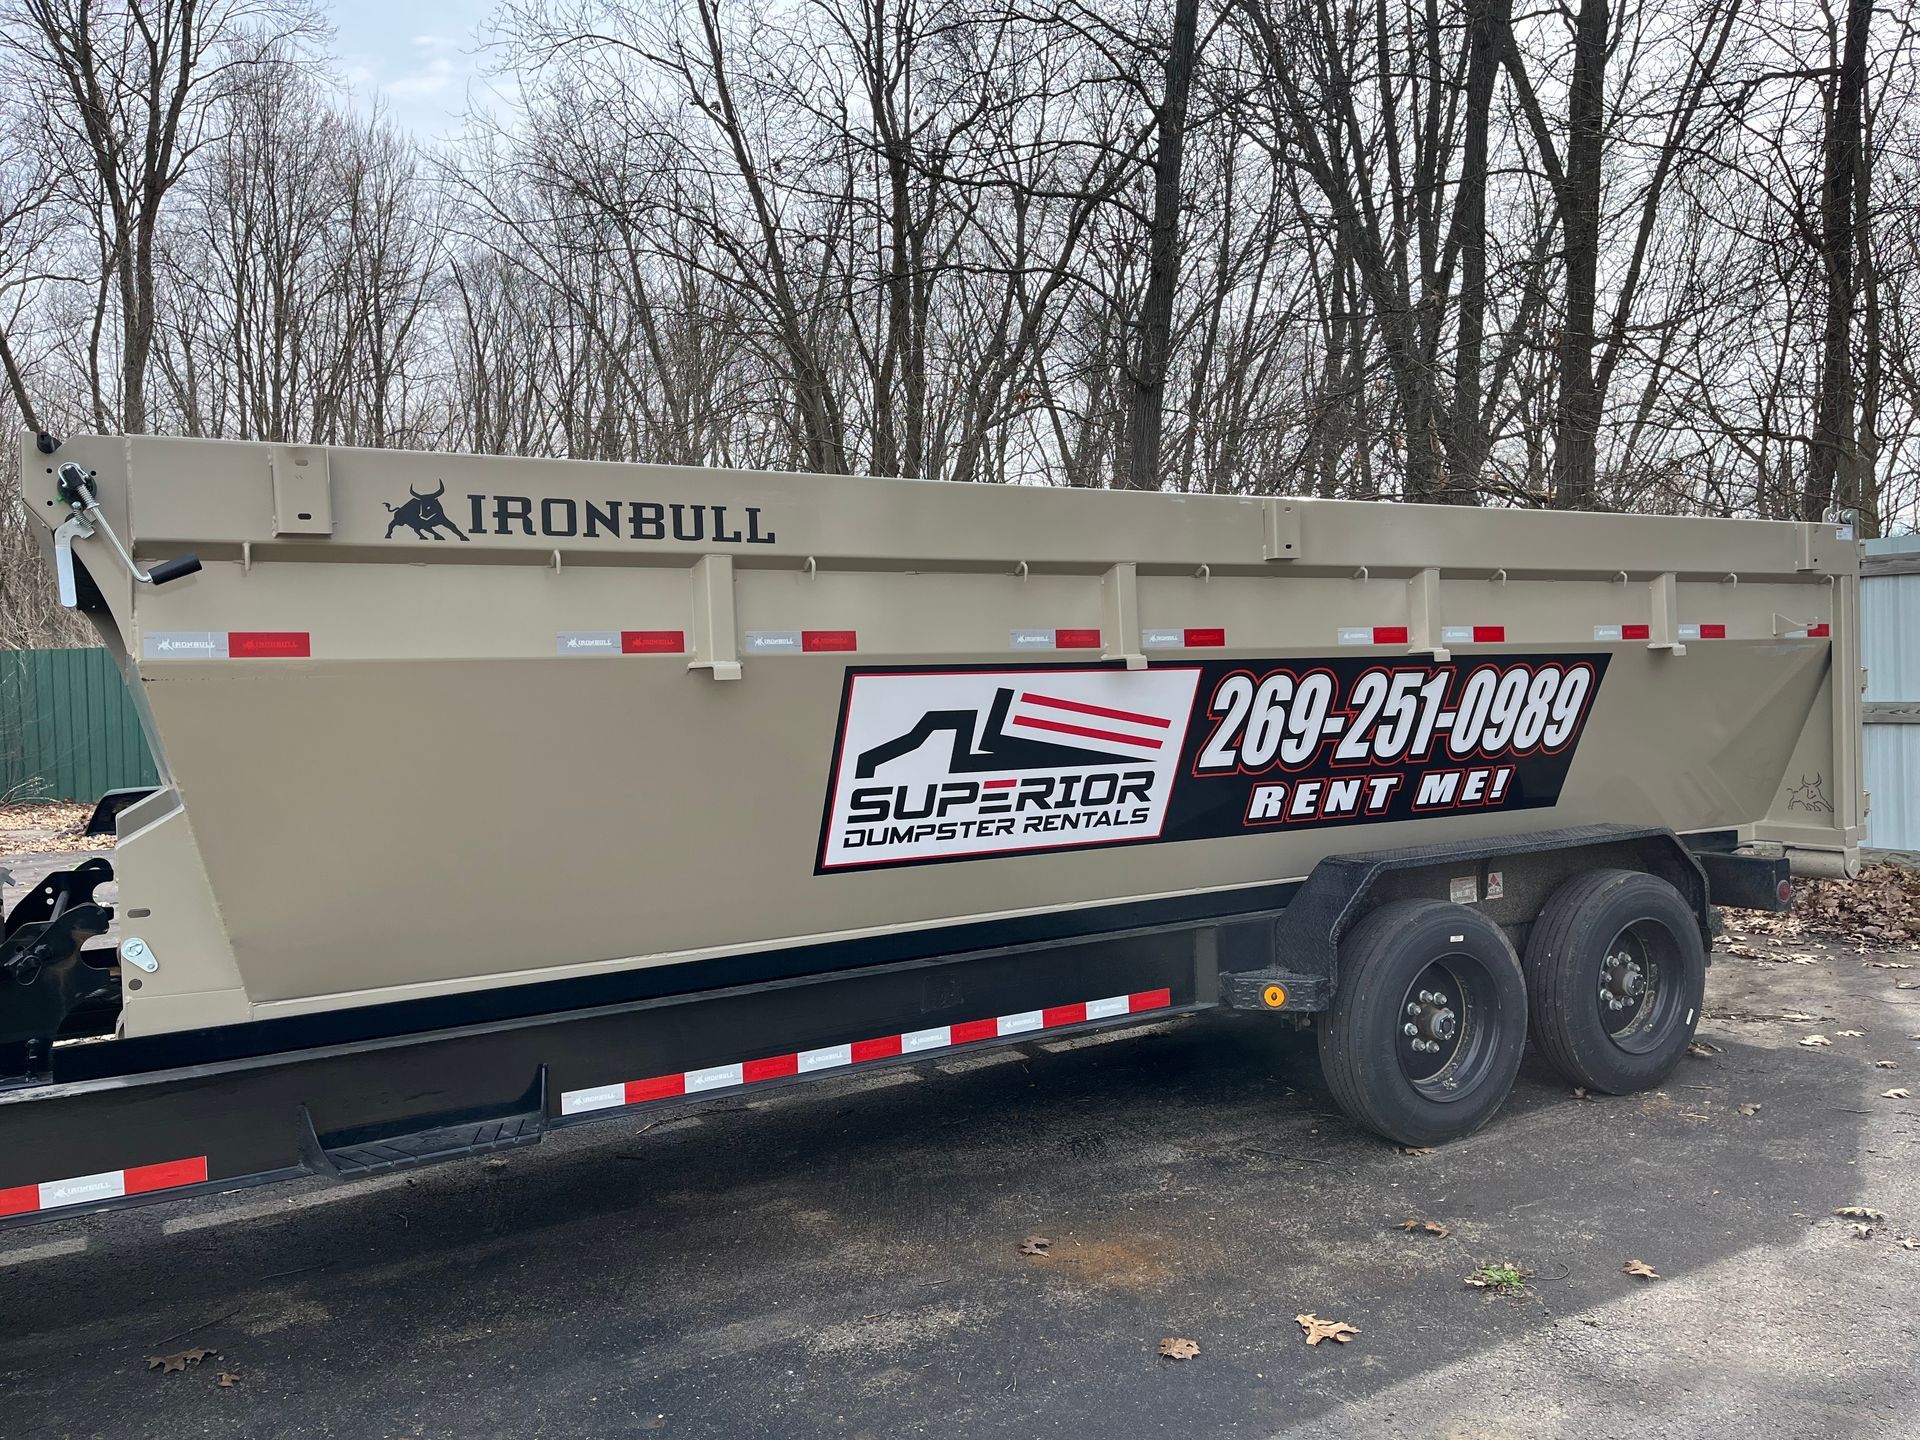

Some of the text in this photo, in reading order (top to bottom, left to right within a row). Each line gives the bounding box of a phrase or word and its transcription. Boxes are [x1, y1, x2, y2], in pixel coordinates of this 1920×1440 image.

[467, 494, 775, 544] IRONBULL
[1198, 666, 1591, 769] 269-251-0989
[846, 770, 1156, 825] SUPERIOR
[1247, 767, 1512, 821] RENT ME!
[842, 807, 1151, 849] DUMPSTER RENTALS
